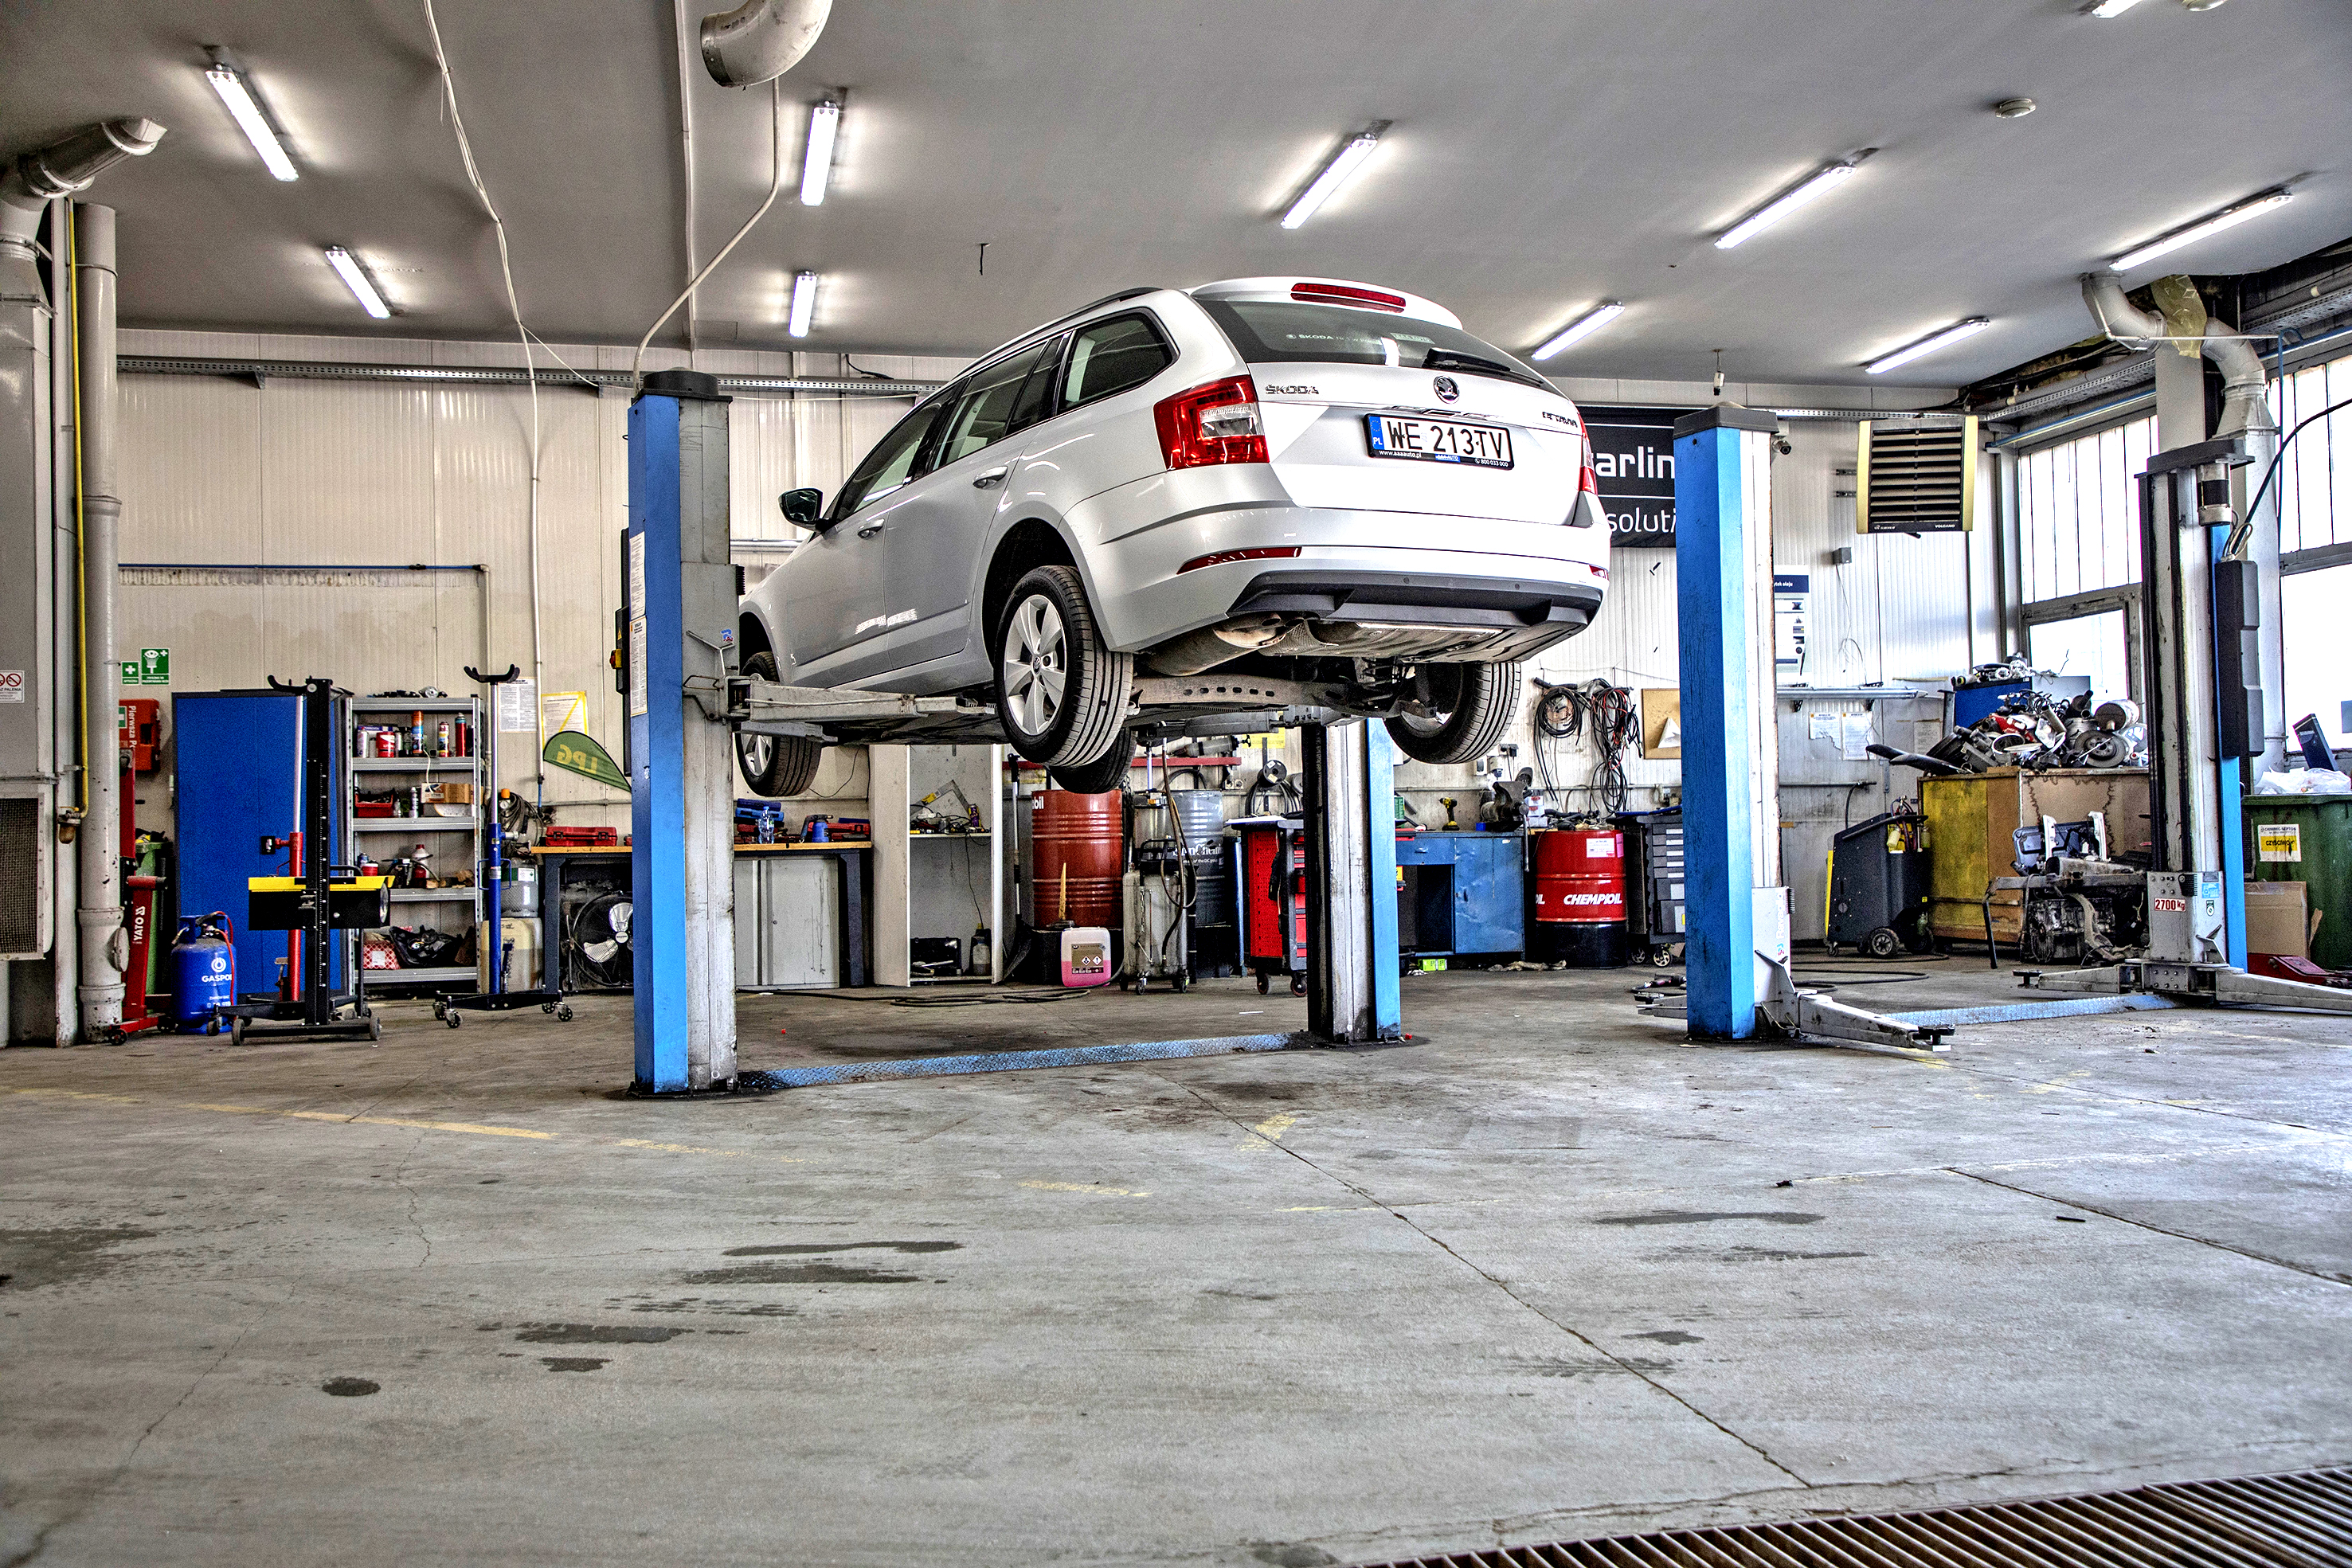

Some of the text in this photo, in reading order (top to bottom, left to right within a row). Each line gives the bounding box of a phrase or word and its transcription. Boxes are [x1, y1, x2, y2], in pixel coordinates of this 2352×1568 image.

[1265, 384, 1320, 395] ŠKODA
[1372, 437, 1383, 446] PL
[1387, 420, 1502, 459] WE 213TV
[1592, 445, 1675, 479] arlin
[128, 705, 137, 738] Pierwsza
[1032, 796, 1044, 810] bil
[1563, 893, 1622, 905] CHEMPIOIL
[2154, 899, 2186, 911] 2700 kg
[133, 917, 144, 941] YATO
